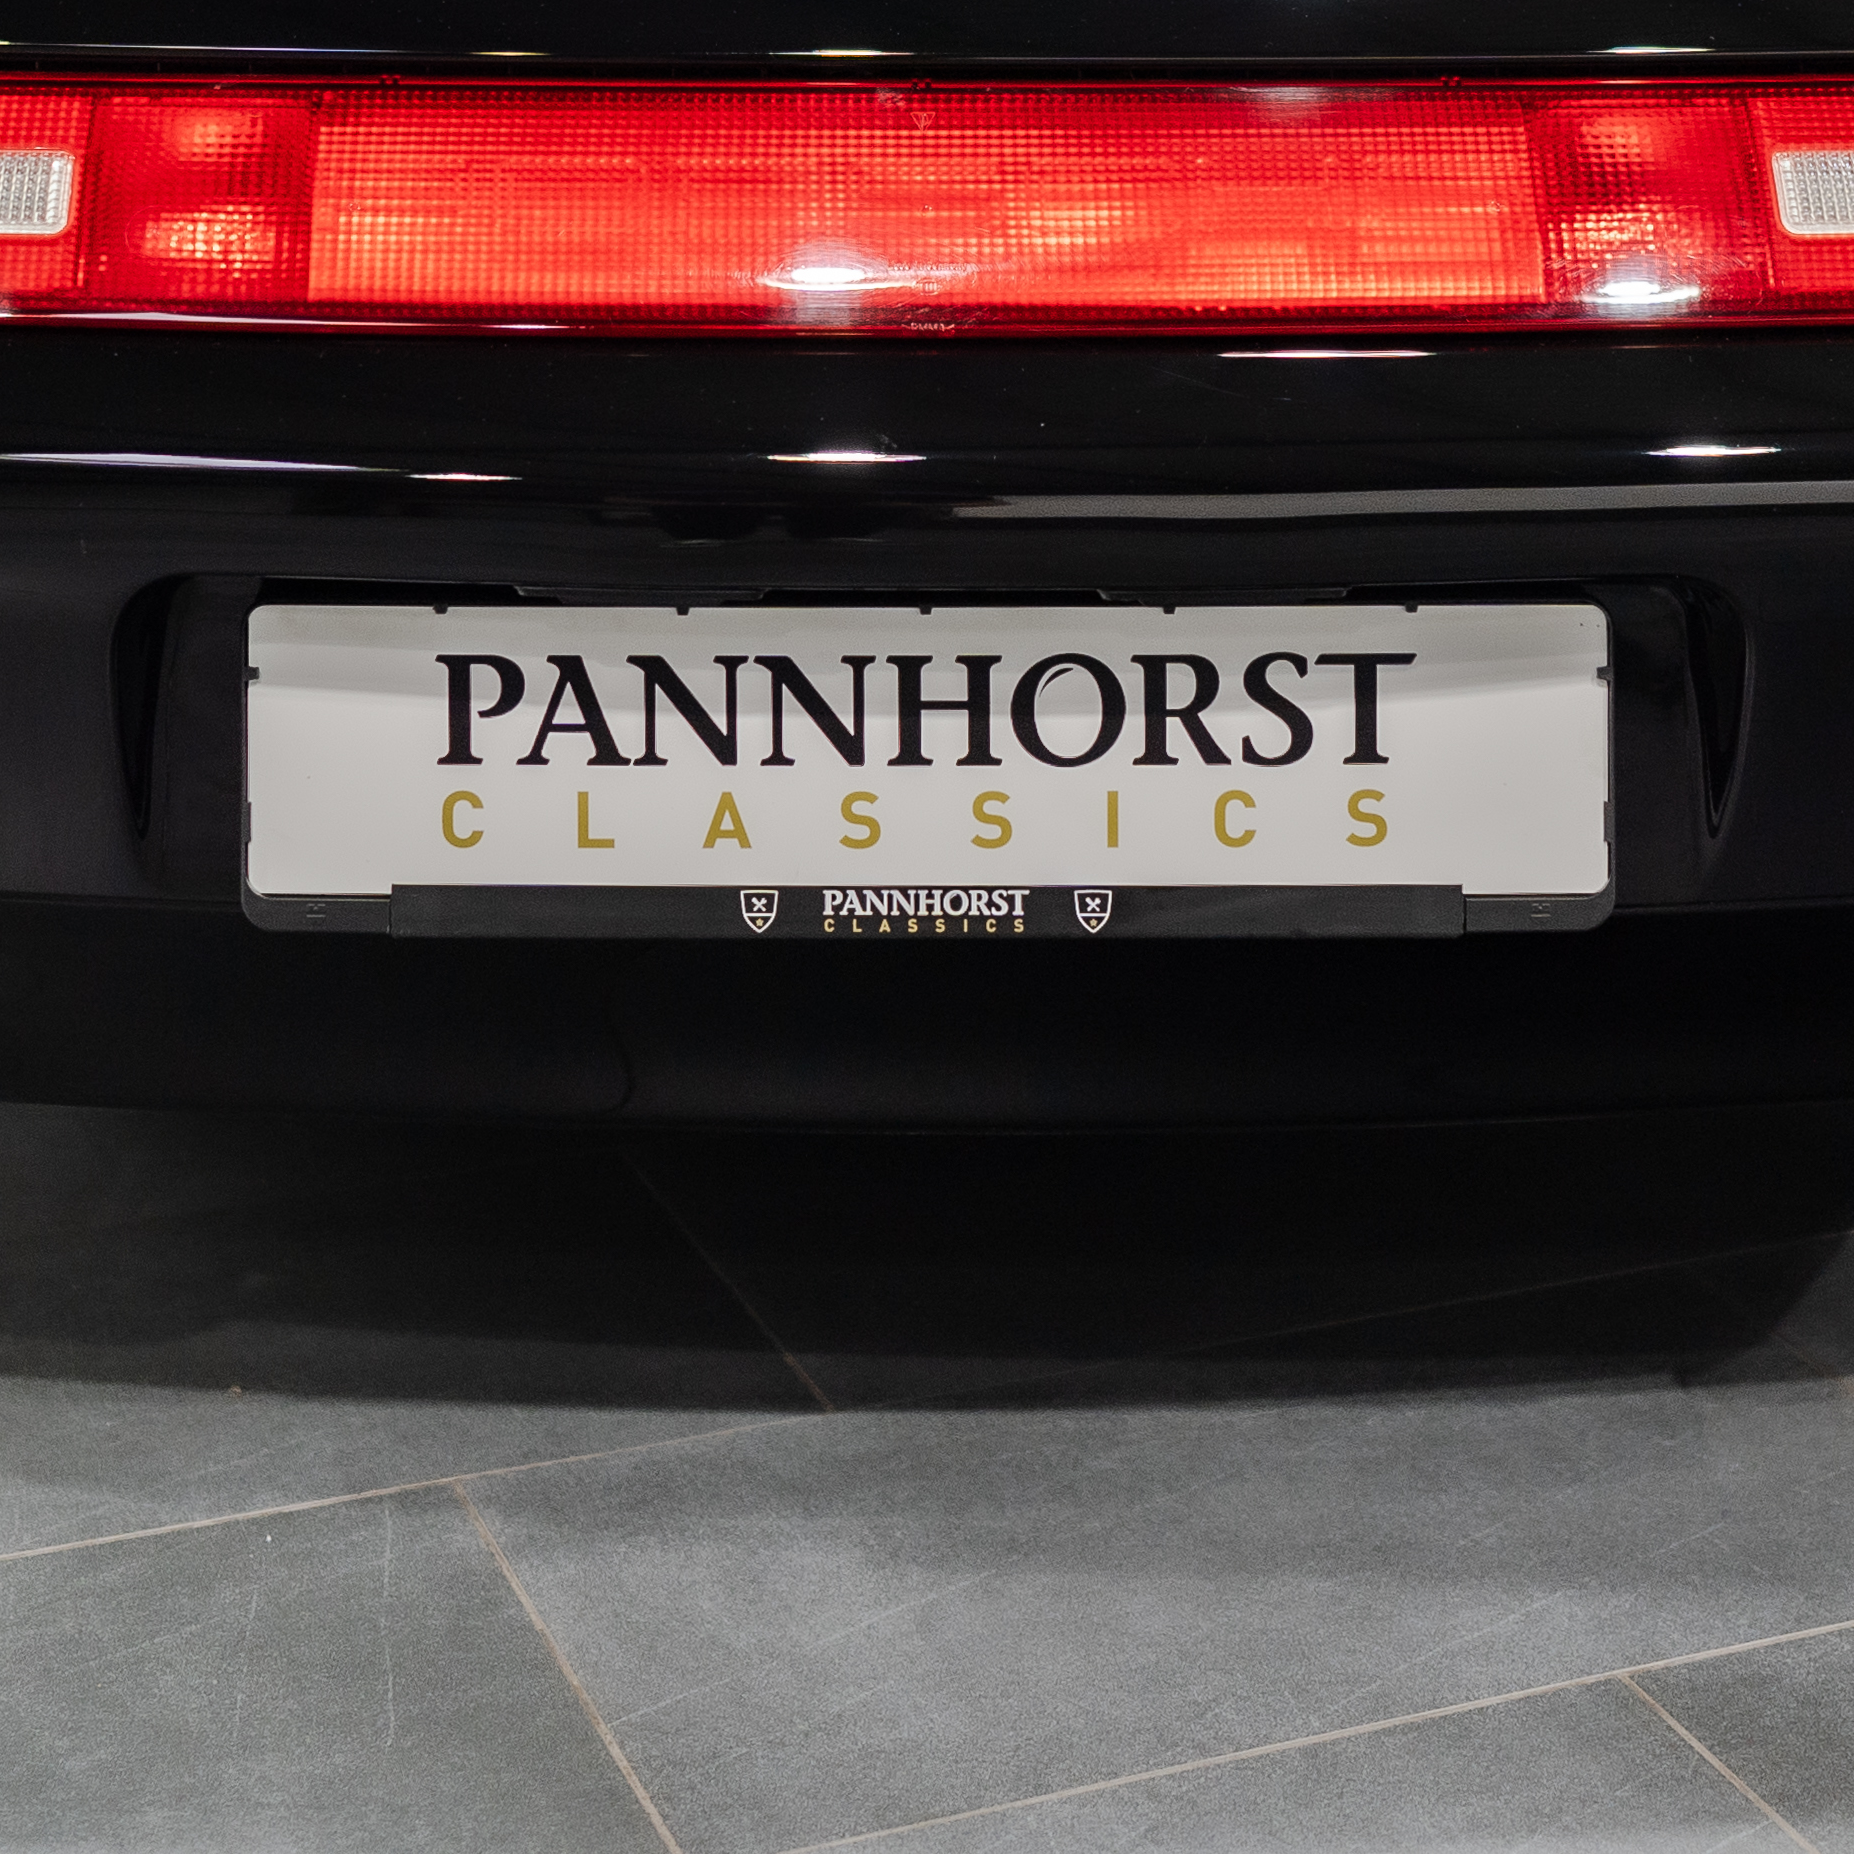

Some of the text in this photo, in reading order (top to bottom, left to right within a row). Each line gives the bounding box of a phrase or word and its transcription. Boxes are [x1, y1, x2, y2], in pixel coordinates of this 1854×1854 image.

[435, 652, 1417, 767] PANNHORST
[441, 789, 1388, 850] CLASSICS
[822, 889, 1030, 917] PANNHORST
[823, 918, 1025, 934] CLASSICS
